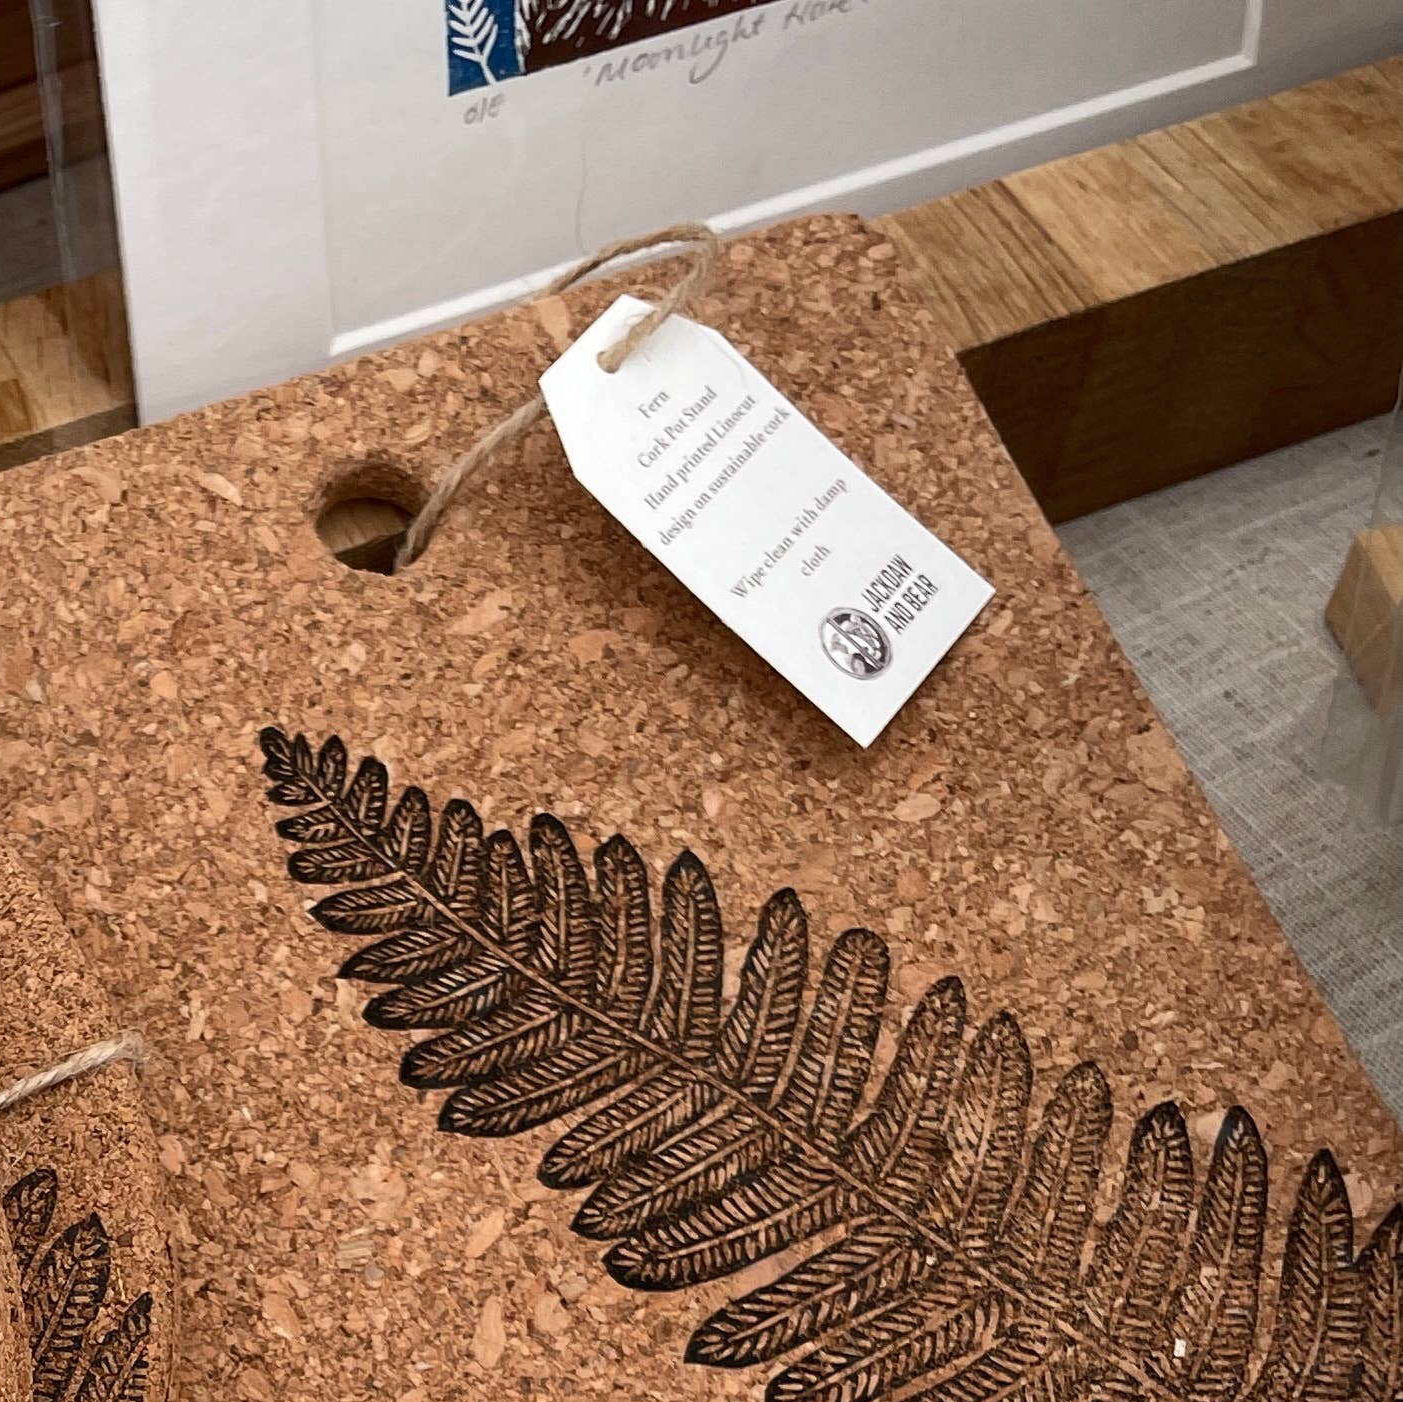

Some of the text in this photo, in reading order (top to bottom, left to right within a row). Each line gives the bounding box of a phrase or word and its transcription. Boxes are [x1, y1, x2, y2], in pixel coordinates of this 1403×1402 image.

[637, 391, 671, 420] Fern
[637, 384, 720, 469] Cork Pot Stand
[643, 394, 757, 511] Hand printed Linocut
[657, 407, 792, 547] design on sustainable cork
[729, 477, 849, 599] Wipe clean with damp
[800, 545, 833, 578] cloth
[861, 554, 913, 613] JACKDAW
[883, 574, 939, 635] AND BEAR
